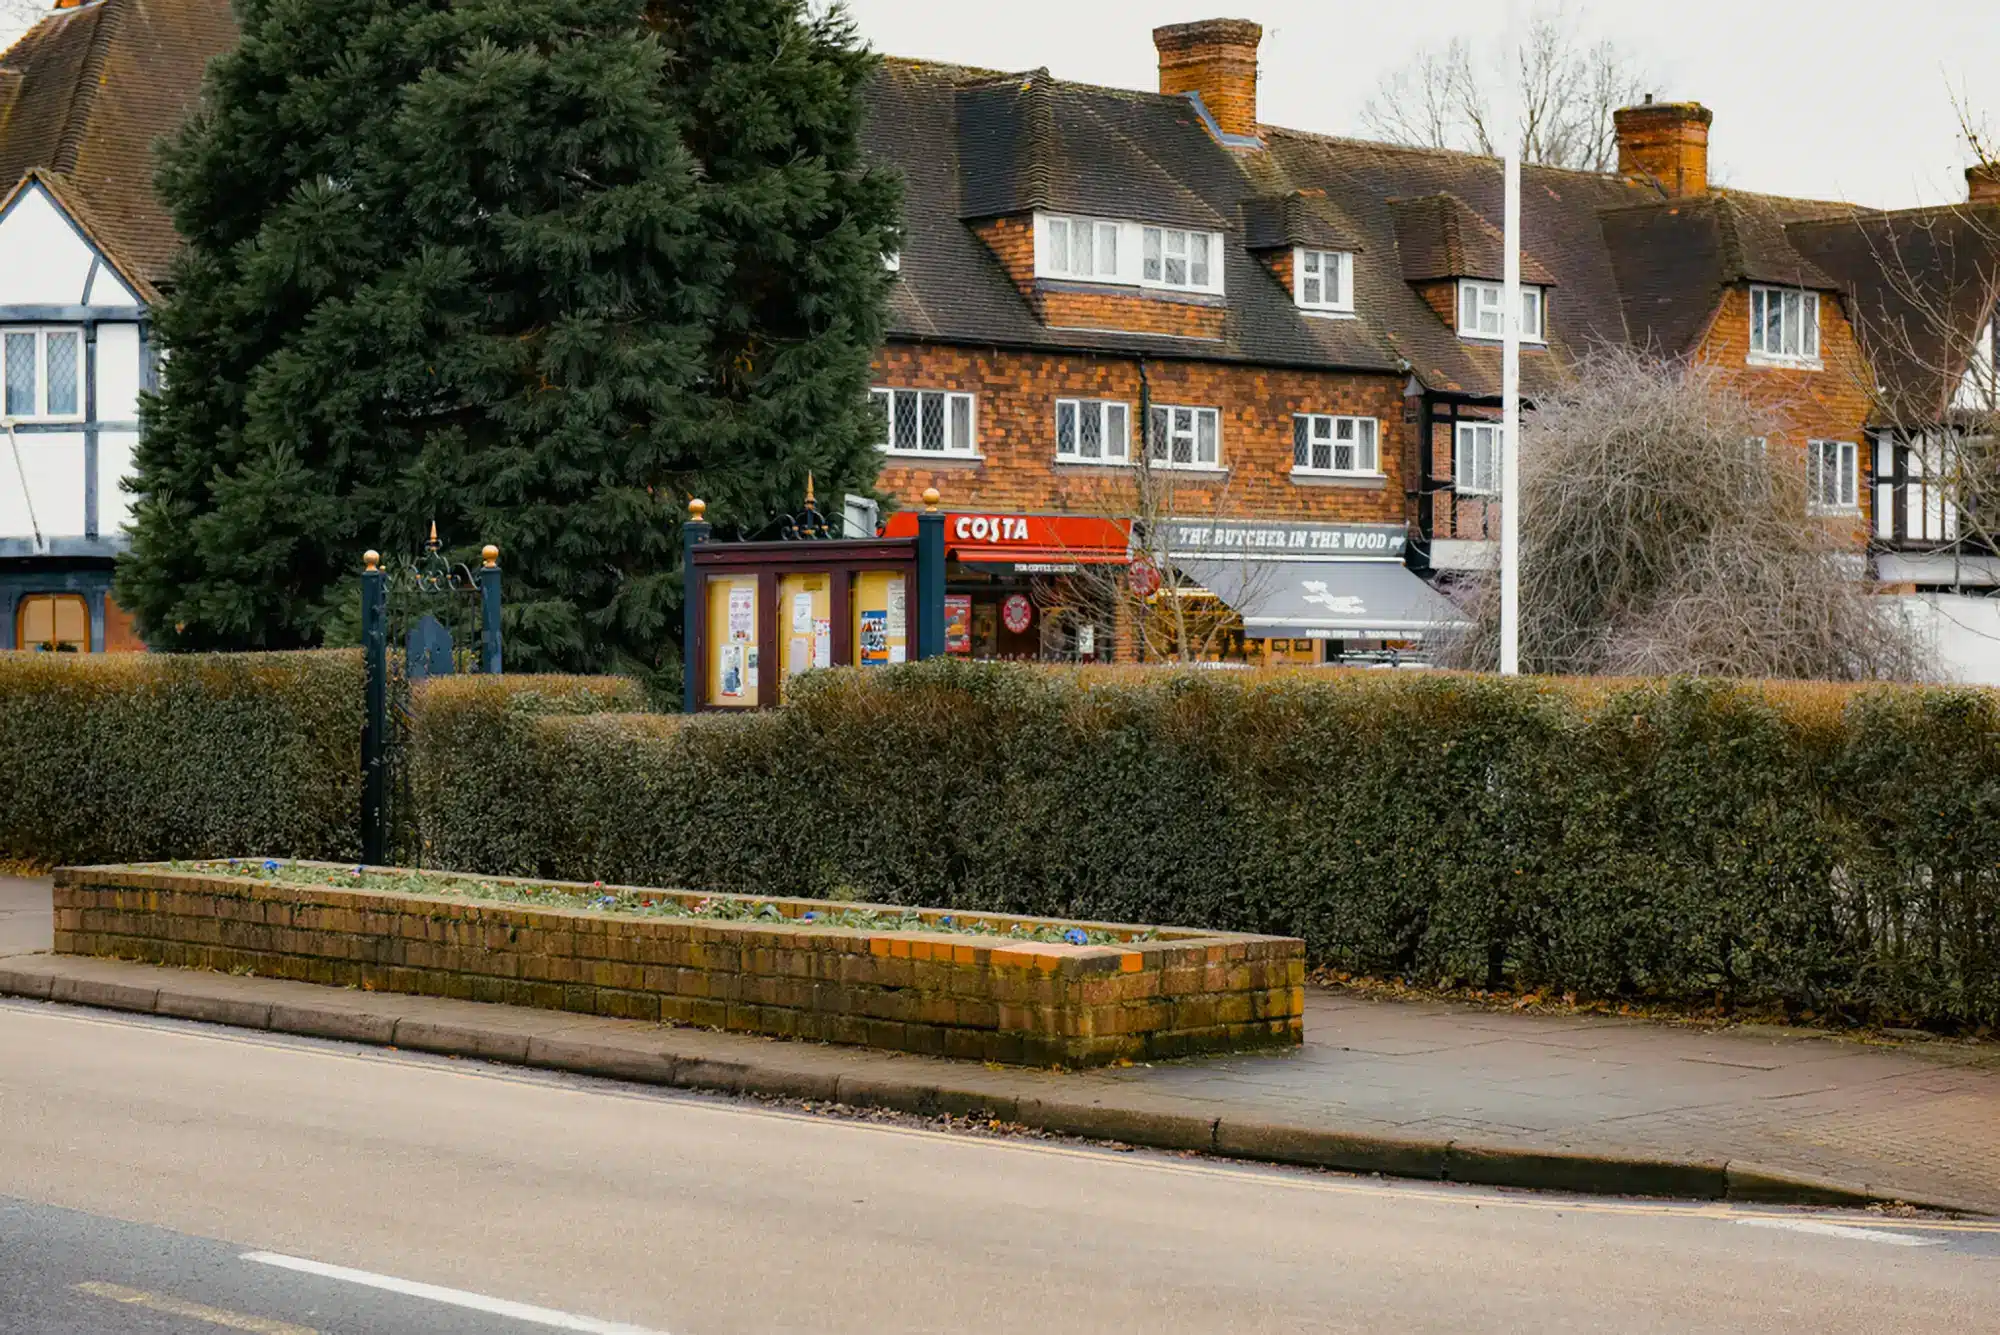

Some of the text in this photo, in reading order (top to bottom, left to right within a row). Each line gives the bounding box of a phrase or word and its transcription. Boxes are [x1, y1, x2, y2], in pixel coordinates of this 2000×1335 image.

[955, 516, 1029, 542] COSTA
[1180, 527, 1387, 549] THE BUTCHER IN THE WOOD
